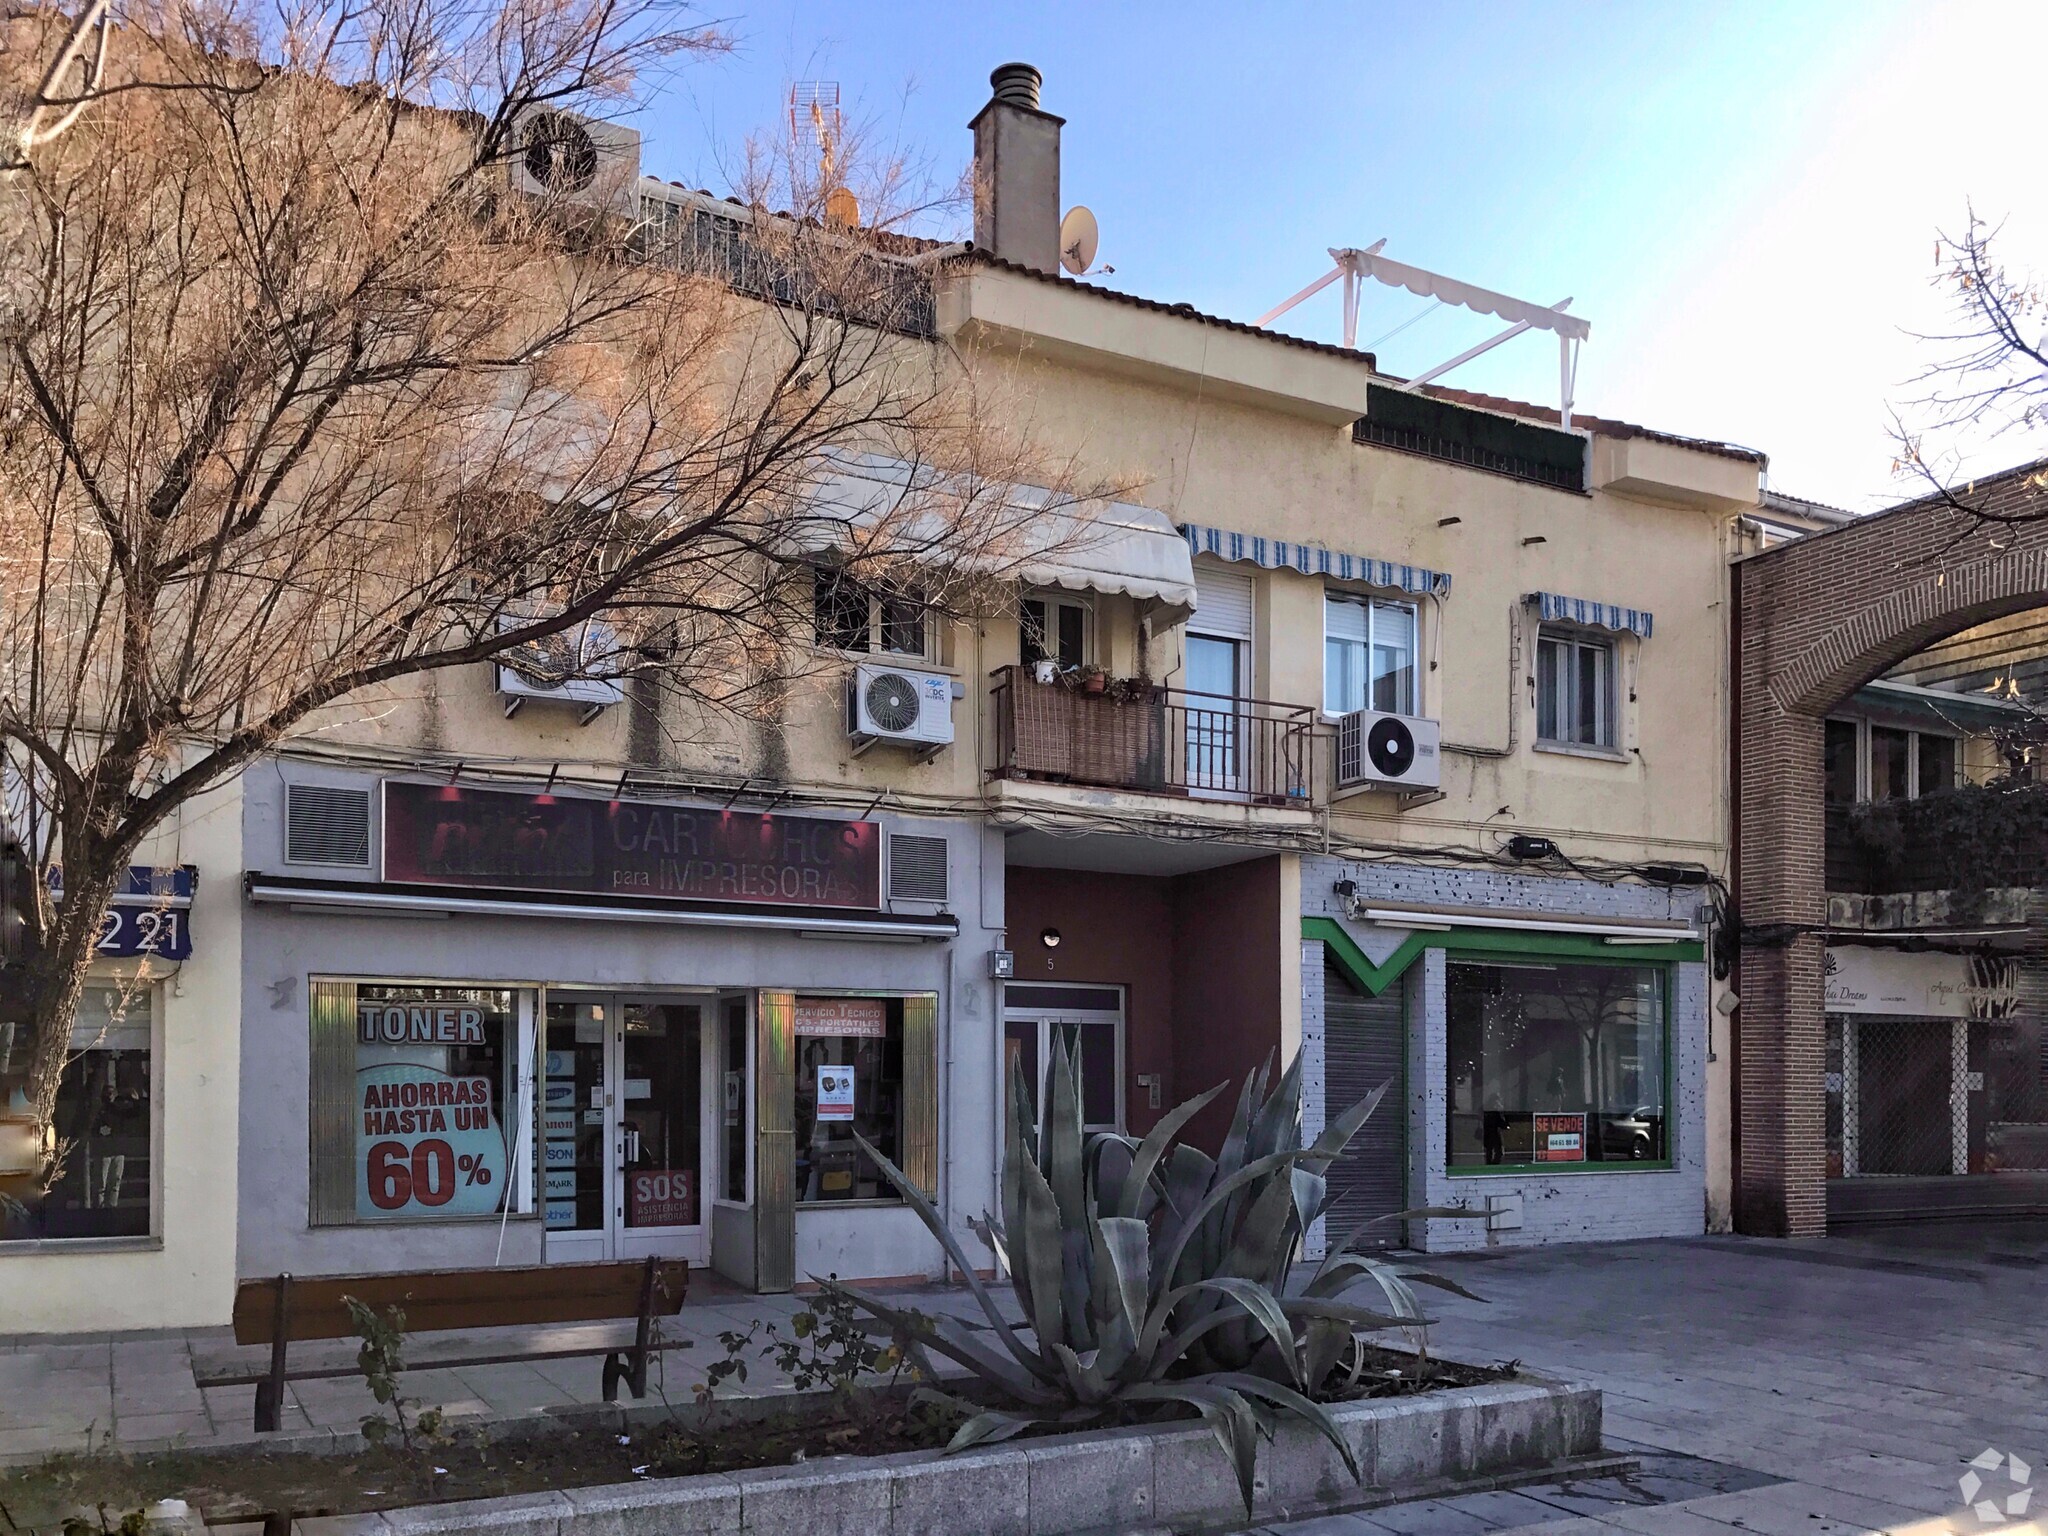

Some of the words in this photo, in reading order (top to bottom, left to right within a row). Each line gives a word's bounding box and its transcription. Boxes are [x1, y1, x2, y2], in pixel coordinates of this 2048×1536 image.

[613, 869, 650, 888] para
[660, 858, 858, 900] IMPRESORAS
[135, 912, 177, 950] 21
[1047, 958, 1054, 970] 5
[360, 1006, 485, 1043] TONER
[795, 1026, 881, 1034] MPRESORAS
[363, 1080, 488, 1109] AHORRAS
[364, 1109, 447, 1136] HASTA
[454, 1107, 489, 1131] UN
[1536, 1117, 1549, 1131] SE
[1550, 1116, 1583, 1131] VENDE
[636, 1173, 688, 1203] SOS
[637, 1202, 689, 1215] ASISTENCIA
[637, 1212, 689, 1223] IMPRESORAS
